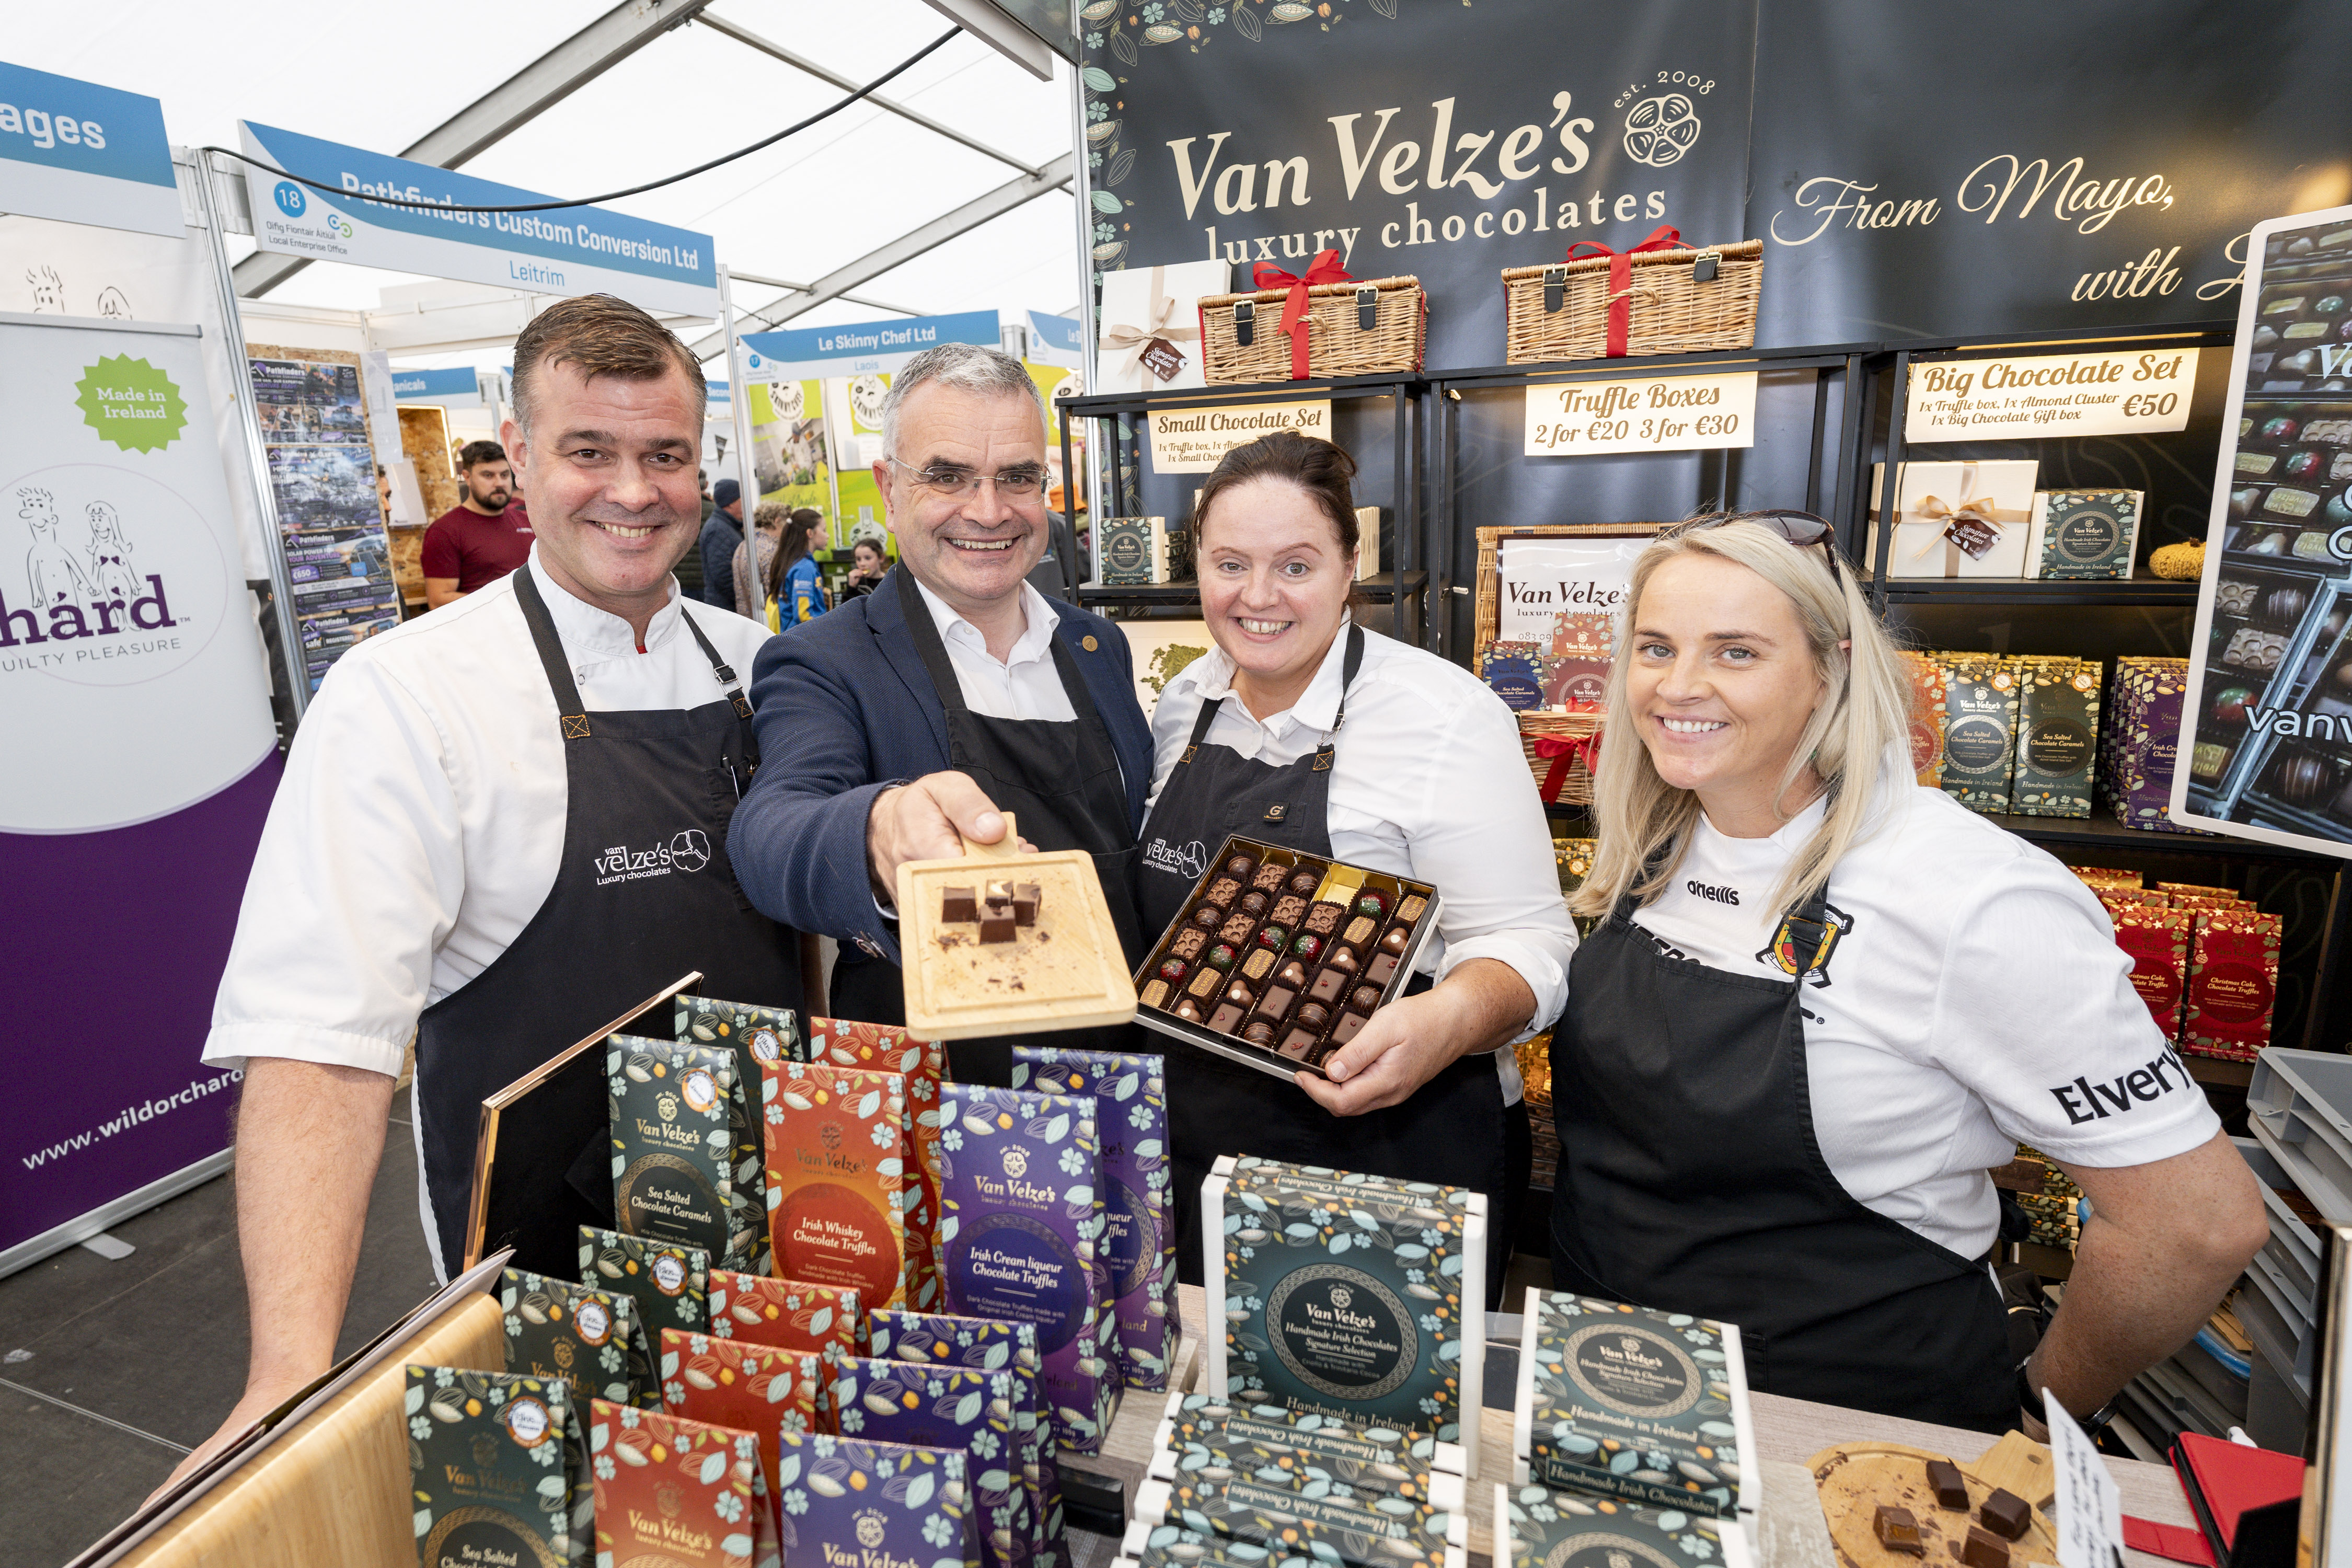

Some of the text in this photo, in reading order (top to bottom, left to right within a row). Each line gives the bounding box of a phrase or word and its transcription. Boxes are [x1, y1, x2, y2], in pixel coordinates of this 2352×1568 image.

[1614, 70, 1716, 108] est. 2008
[1166, 91, 1595, 219] Van Velze's
[279, 189, 301, 209] 18
[1770, 154, 2175, 246] From Mayo,
[266, 221, 284, 233] Oifig
[286, 224, 314, 236] Fiontair
[1380, 186, 1666, 249] chocolates
[269, 235, 348, 255] Local Enterprise Office
[494, 211, 573, 245] Custom
[577, 224, 672, 265] Conversion
[674, 249, 698, 270] Ltd
[509, 260, 566, 287] Leitrim
[2071, 246, 2182, 302] with
[818, 326, 936, 351] Le Skinny Chef Ltd
[751, 356, 759, 367] 17
[855, 360, 879, 371] Laois
[1146, 352, 1173, 368] Chocolates
[1151, 347, 1178, 363] Signature
[266, 366, 305, 376] Pathfinders
[1924, 354, 2183, 398] Big Chocolate Set
[96, 386, 166, 402] Made in
[1559, 383, 1720, 419] Truffle Boxes
[1919, 392, 2119, 416] 1x Truffle box, 1x Almond Cluster
[2122, 392, 2178, 418] €50
[103, 404, 168, 419] Ireland
[1158, 408, 1322, 434] Small Chocolate Set
[1931, 409, 2082, 426] 1x Big Chocolate Gift box
[1535, 414, 1739, 448] 2 for €20 3 for €30
[1159, 441, 1221, 454] 1x Truffle box, 1x
[1168, 453, 1201, 462] 1x Small
[299, 535, 335, 544] Pathfinders
[1954, 529, 1985, 545] Chocolates
[1961, 524, 1989, 539] Signature
[293, 569, 311, 580] €650
[1507, 581, 1552, 604] Van
[0, 574, 177, 648] hard
[315, 617, 349, 627] Pathfinders
[1518, 632, 1536, 642] 083
[1578, 643, 1598, 651] Velze's
[76, 638, 182, 662] PLEASURE
[1960, 700, 2001, 710] Van Velze's
[1942, 777, 1974, 786] Handmade
[1982, 778, 2003, 787] Ireland
[594, 842, 671, 875] velze's
[605, 846, 622, 856] van
[596, 867, 671, 885] Luxury chocolates
[1142, 857, 1178, 874] Luxury chocolates
[1687, 879, 1740, 906] o'neills
[2207, 983, 2259, 995] Chocolate Truffles
[2210, 977, 2240, 986] Christmas
[636, 1117, 701, 1145] Van Velze's
[648, 1185, 691, 1205] Sea Salted
[974, 1174, 1056, 1203] Van Velze's
[631, 1195, 712, 1224] Chocolate Caramels
[801, 1216, 863, 1242] Irish Whiskey
[793, 1229, 877, 1256] Chocolate Truffles
[970, 1247, 1063, 1274] Irish Cream liqueur
[972, 1262, 1058, 1289] Chocolate Truffles
[1306, 1302, 1377, 1329] Van Velze's
[1285, 1322, 1398, 1353] Handmade Irish Chocolates
[1305, 1337, 1377, 1359] Signature Selection
[1286, 1396, 1416, 1433] Handmade in Ireland
[1550, 1463, 1716, 1516] Handmade Irish Chocolates
